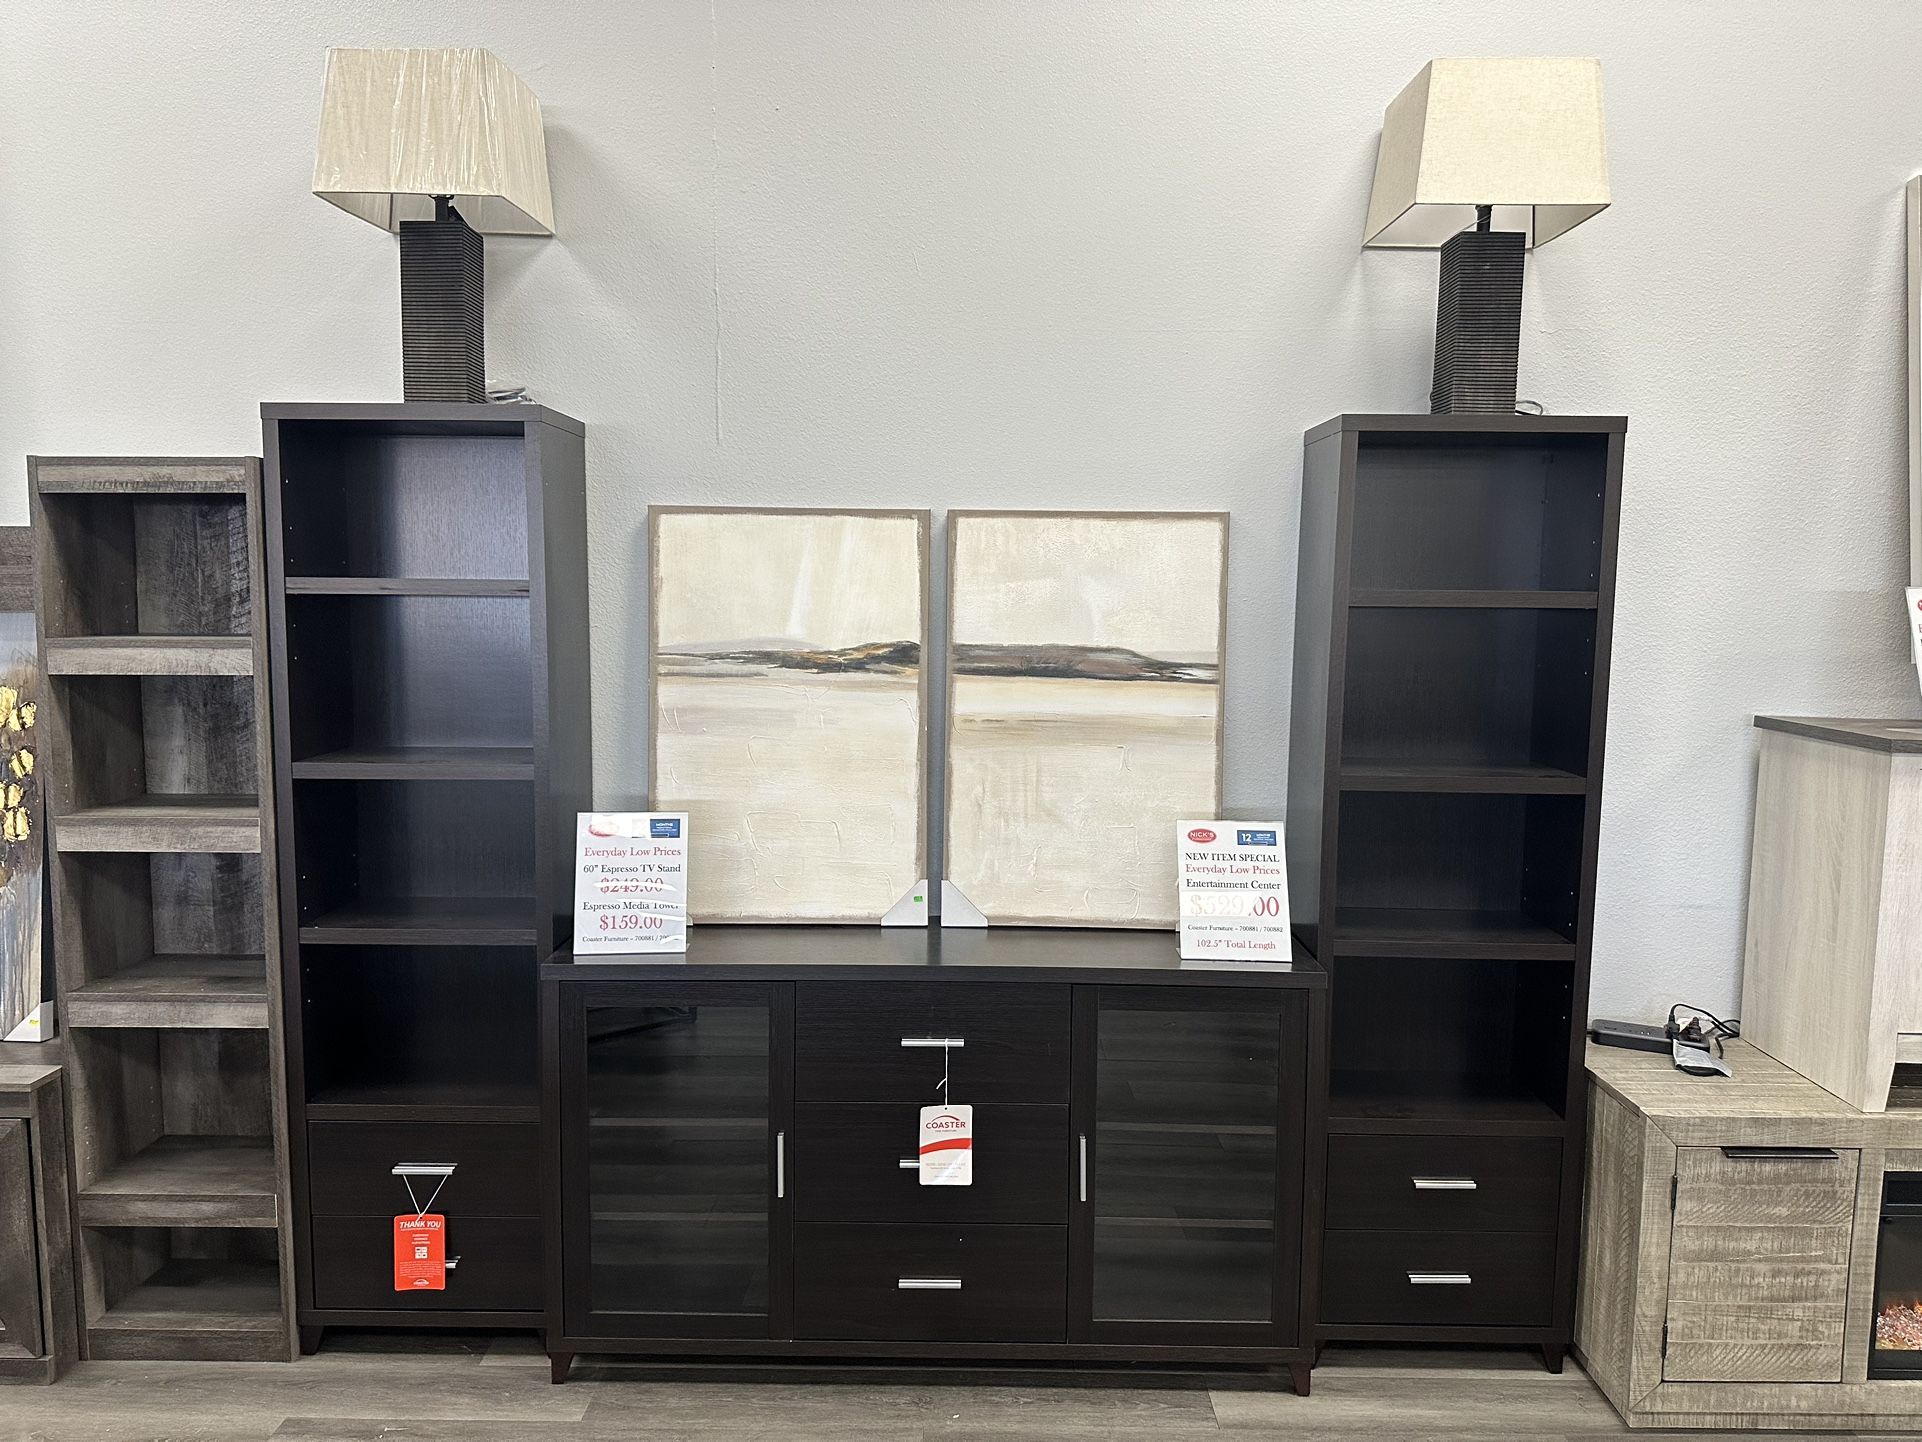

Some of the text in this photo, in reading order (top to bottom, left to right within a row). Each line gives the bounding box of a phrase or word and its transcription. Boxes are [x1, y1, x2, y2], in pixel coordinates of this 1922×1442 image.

[1241, 833, 1252, 842] 12
[584, 846, 681, 858] Everyday Low Prices
[1185, 853, 1280, 862] NEW ITEM SPECIAL
[601, 864, 638, 876] Espresso
[640, 864, 655, 873] TV
[657, 864, 681, 873] Stand
[1185, 864, 1280, 875] Everyday Low Prices
[1186, 879, 1281, 890] Entertainment Center
[583, 901, 620, 912] Espresso
[623, 901, 650, 911] Media
[599, 914, 663, 931] $159.00
[1224, 940, 1247, 948] Total
[1248, 941, 1276, 950] Length
[926, 1121, 966, 1129] COASTER
